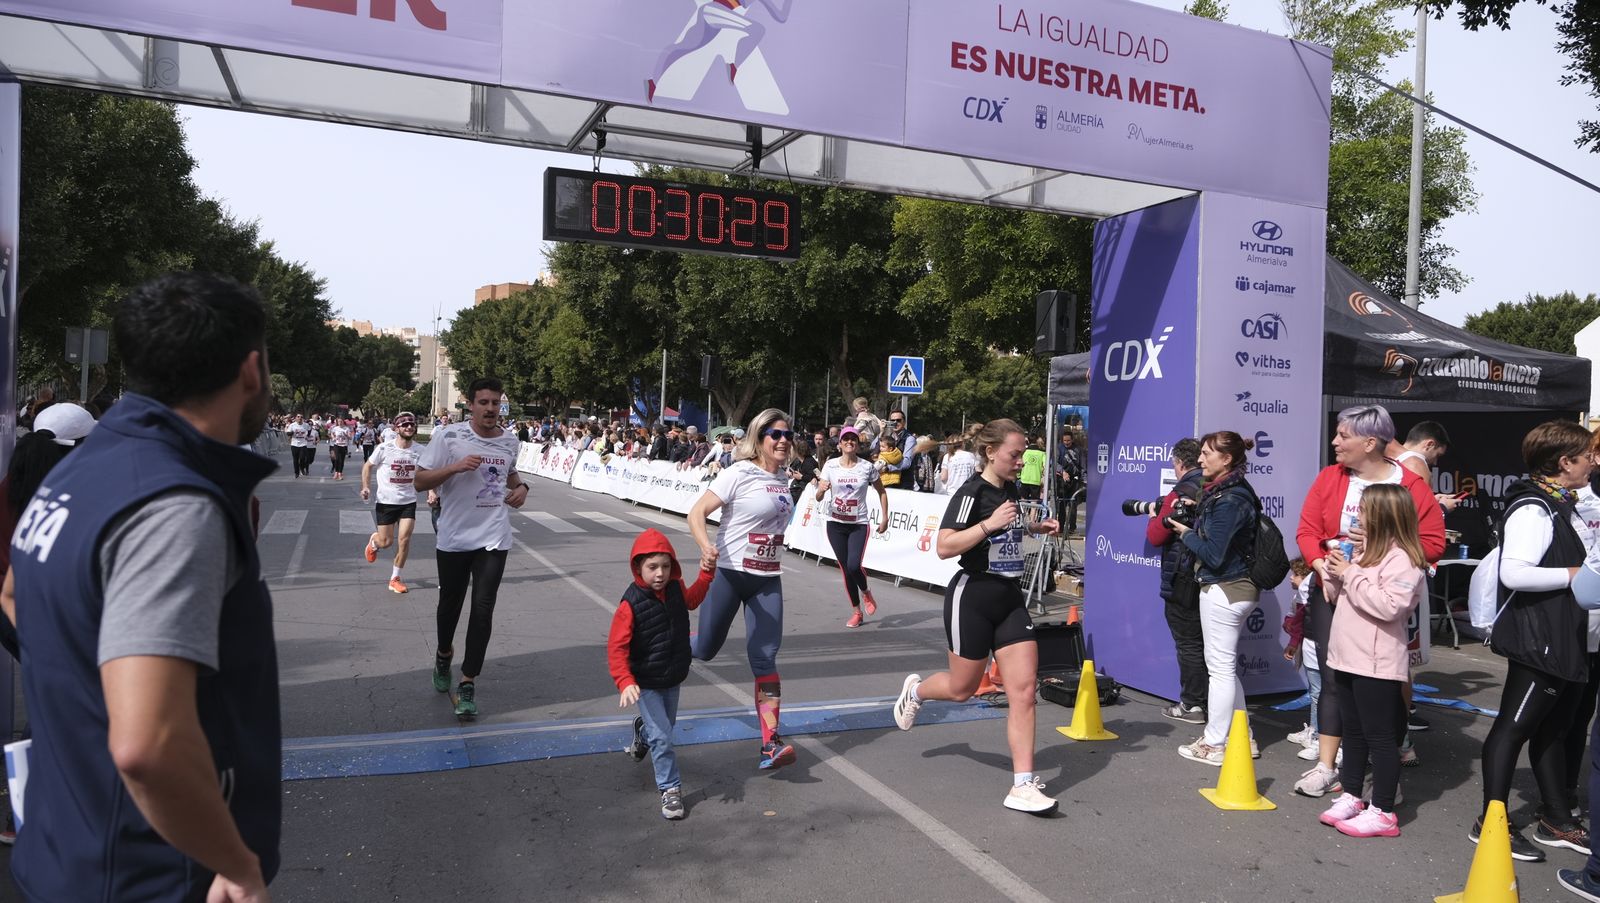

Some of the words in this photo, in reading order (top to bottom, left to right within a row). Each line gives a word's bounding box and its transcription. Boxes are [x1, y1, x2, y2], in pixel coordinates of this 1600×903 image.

[998, 4, 1030, 36] LA
[1039, 13, 1169, 64] IGUALDAD
[951, 41, 987, 73] ES
[994, 49, 1123, 100] NUESTRA
[1128, 77, 1206, 114] META.
[963, 97, 1007, 123] CDX
[1057, 110, 1104, 129] ALMERÍA
[1056, 123, 1082, 134] CIUDAD
[592, 181, 789, 250] 00:30:29
[1240, 241, 1293, 256] HYUNDAI
[1253, 280, 1296, 294] cajamar
[1241, 319, 1279, 340] CASI
[1104, 335, 1167, 382] CDX
[1252, 354, 1291, 369] vithas
[1243, 400, 1288, 416] aqualia
[1118, 463, 1146, 473] CIUDAD
[837, 505, 851, 513] 684
[756, 545, 777, 558] 613
[999, 543, 1020, 556] 498
